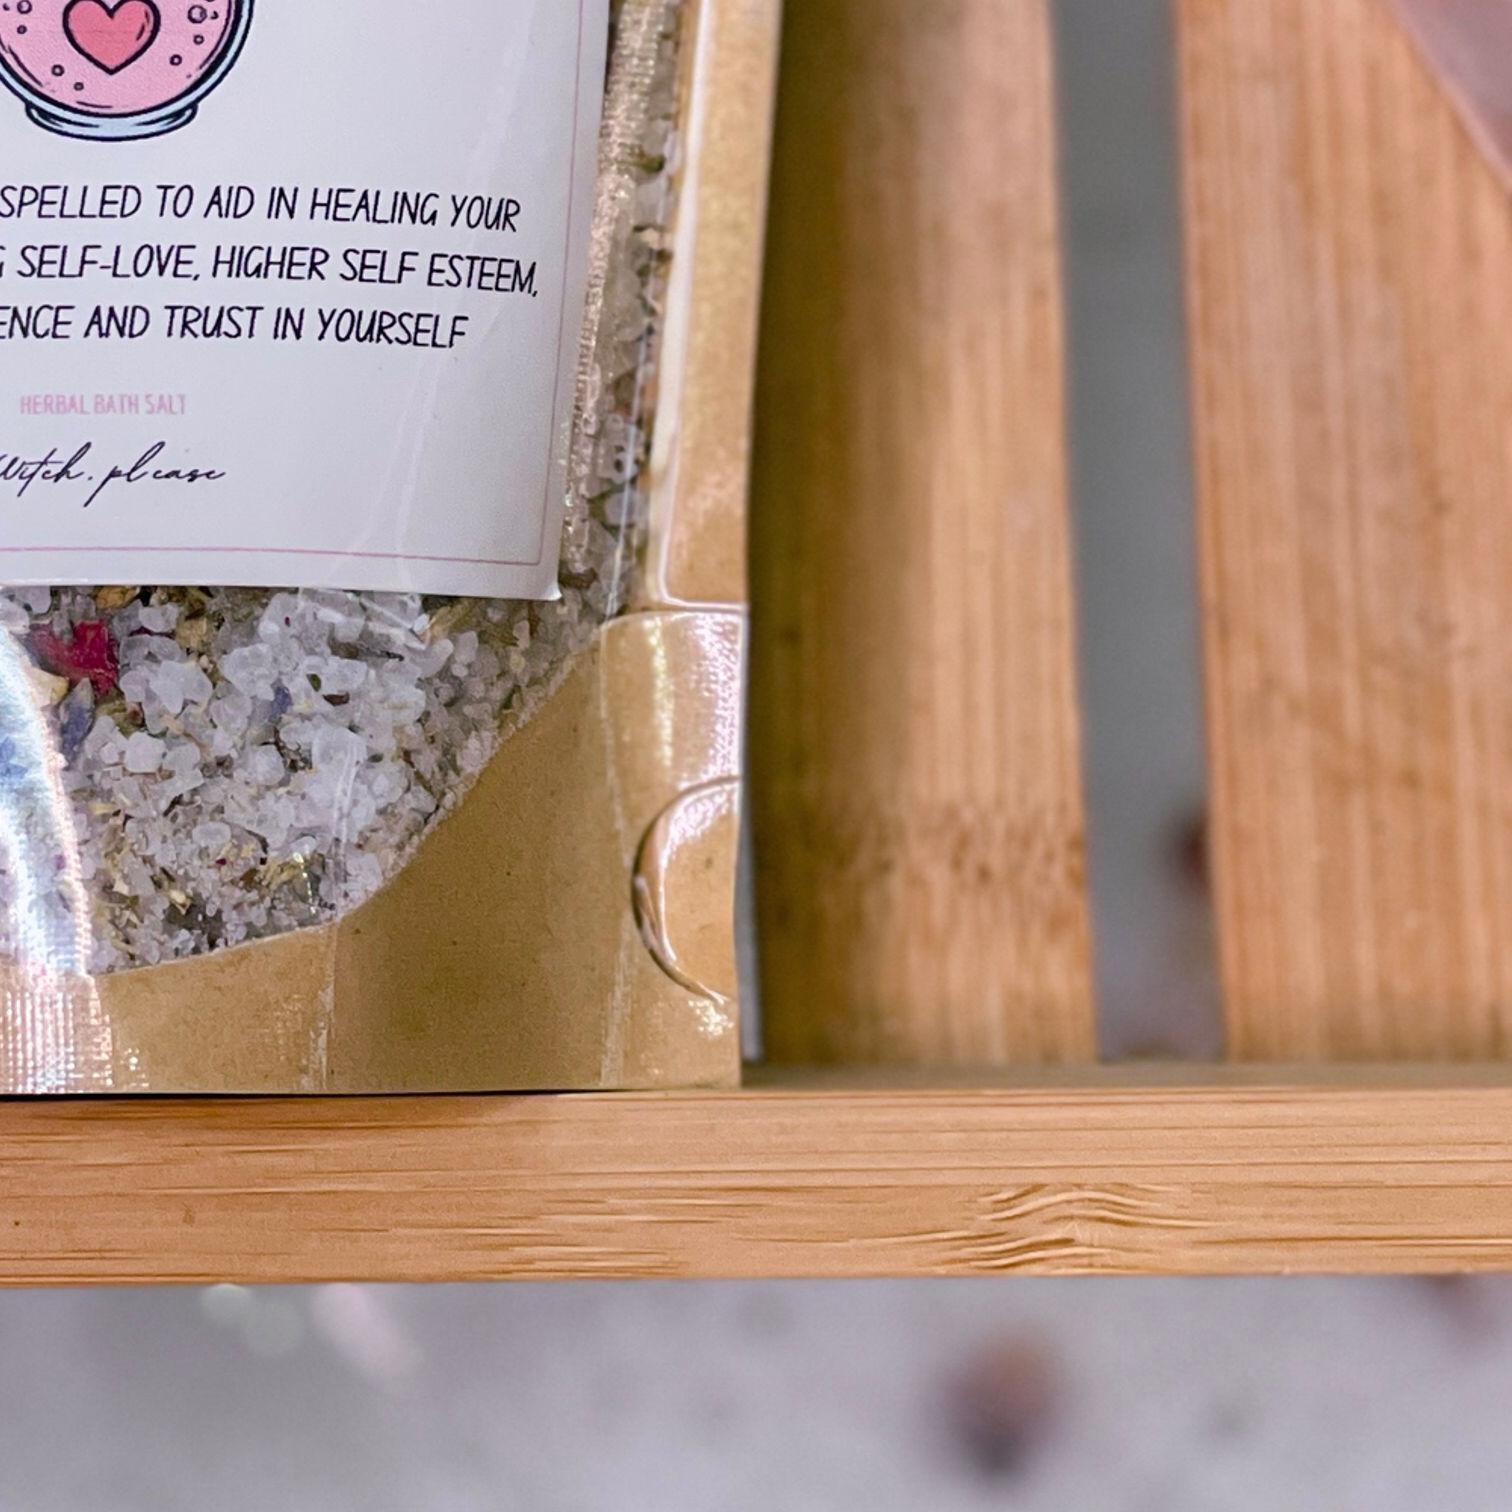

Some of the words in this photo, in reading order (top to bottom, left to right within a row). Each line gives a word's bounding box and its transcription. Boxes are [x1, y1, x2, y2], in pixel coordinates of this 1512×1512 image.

[156, 184, 194, 218] TO
[203, 185, 254, 219] AID
[267, 187, 299, 220] IN
[310, 188, 439, 227] HEALING
[451, 195, 520, 232] YOUR
[17, 244, 200, 282] SELF-LOVE,
[212, 245, 328, 281] HIGHER
[339, 248, 419, 285] SELF
[428, 252, 538, 297] ESTEEM,
[84, 304, 150, 339] AND
[164, 305, 264, 340] TRUST
[273, 307, 305, 341] IN
[318, 308, 469, 348] YOURSELF
[20, 394, 90, 415] HERBAL
[94, 394, 140, 415] BATH
[145, 394, 186, 415] SALT
